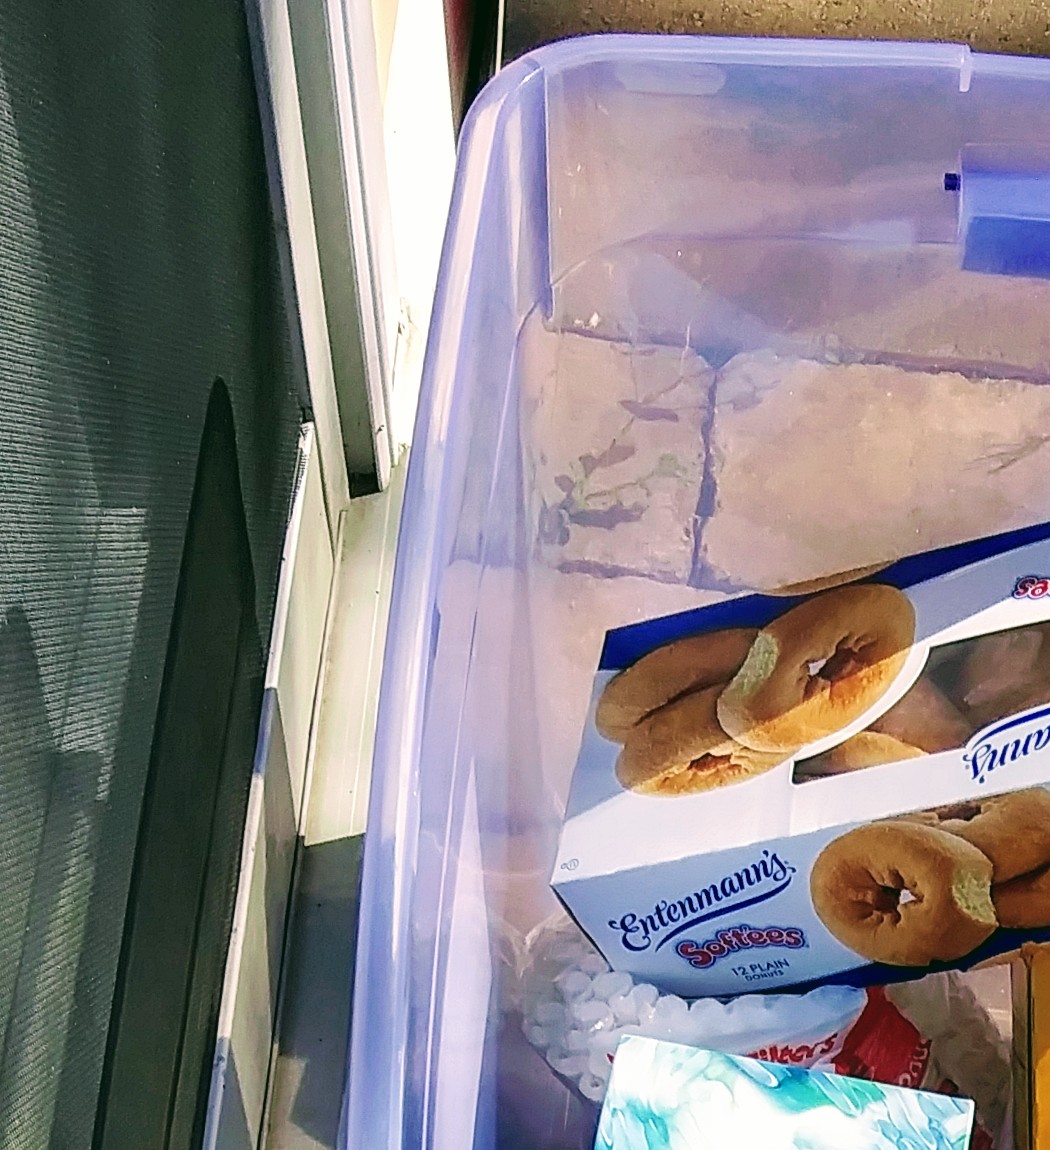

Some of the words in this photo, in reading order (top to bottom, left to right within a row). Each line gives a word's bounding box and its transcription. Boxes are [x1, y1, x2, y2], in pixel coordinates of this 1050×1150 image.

[608, 850, 797, 951] Entenmann's
[732, 966, 748, 976] 12
[749, 958, 790, 973] PLAIN
[745, 970, 784, 982] DONUTS
